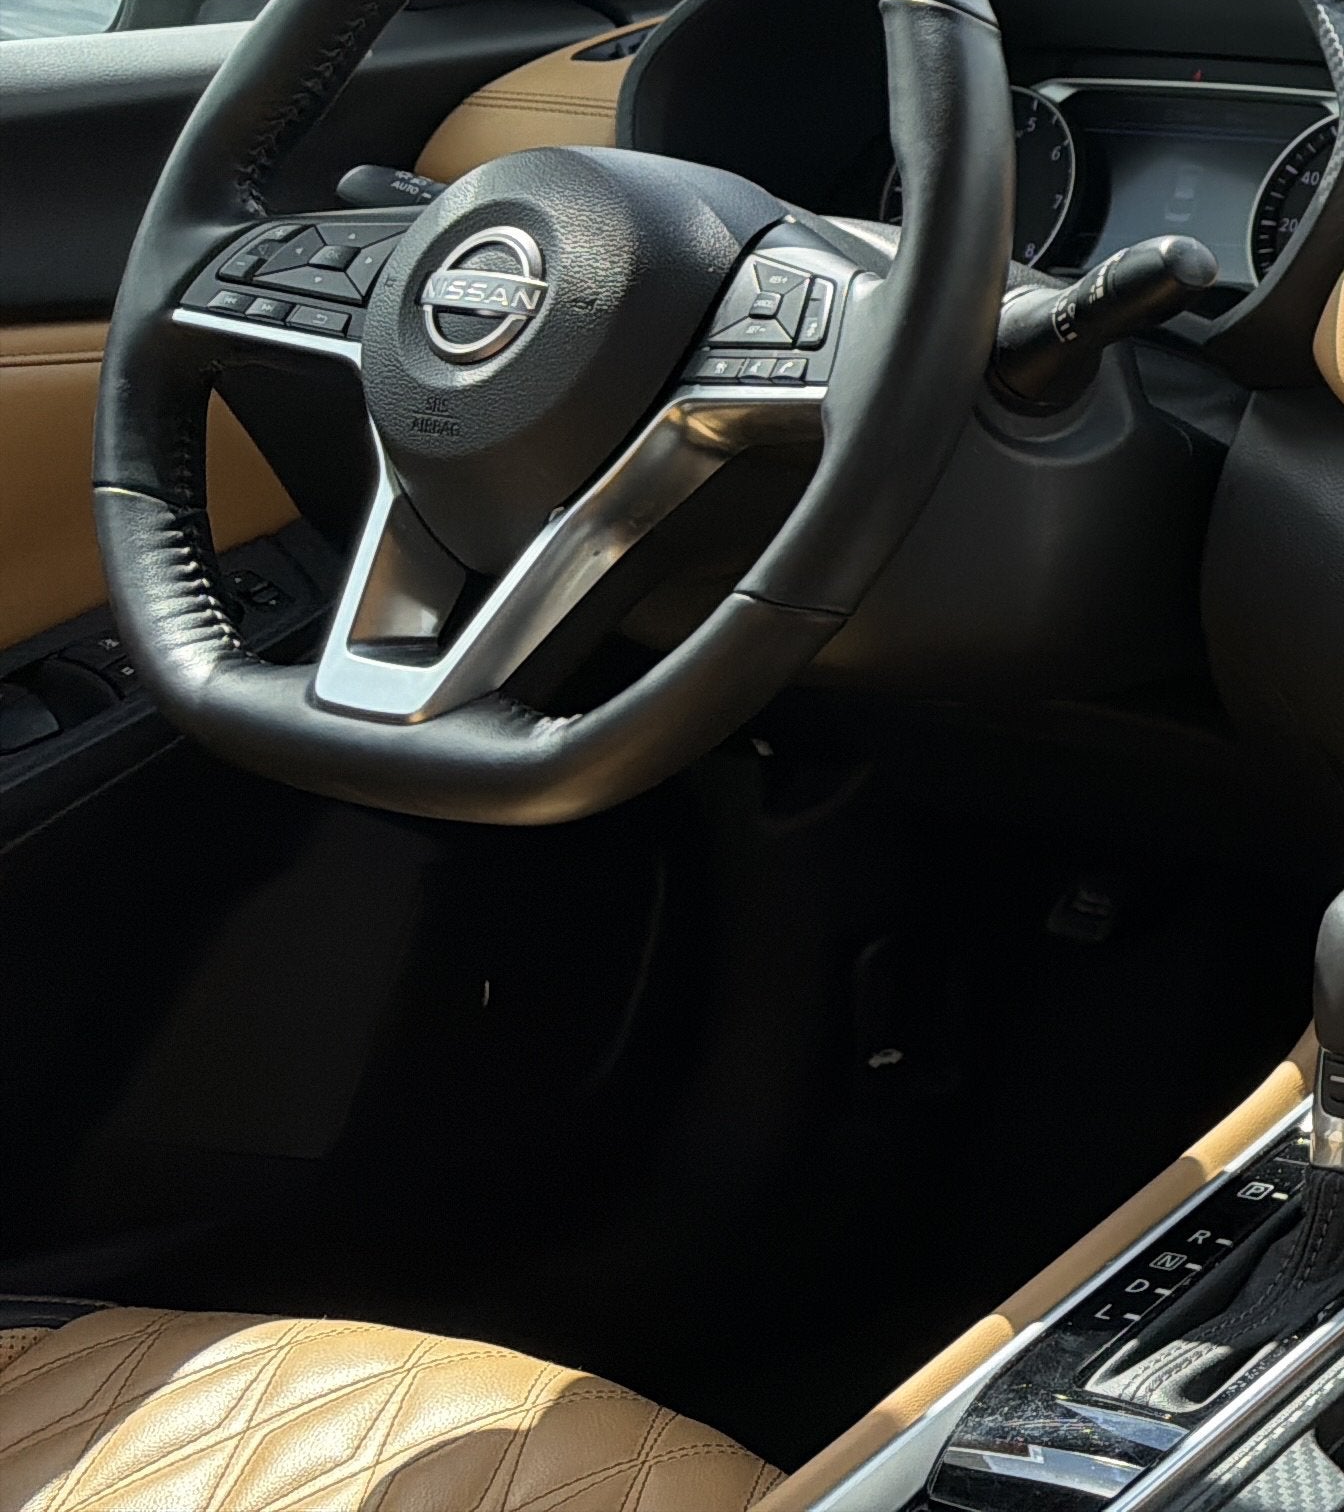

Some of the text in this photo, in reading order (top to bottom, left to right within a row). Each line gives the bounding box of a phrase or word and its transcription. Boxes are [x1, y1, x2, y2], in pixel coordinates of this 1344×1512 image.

[1027, 117, 1037, 134] 5
[1051, 145, 1061, 160] 6
[1301, 170, 1320, 187] 40
[1054, 194, 1063, 210] 7
[1279, 218, 1297, 233] 20
[1024, 243, 1035, 258] 8
[422, 278, 541, 310] NISSAN
[1245, 1185, 1264, 1196] P
[1187, 1230, 1211, 1244] R
[1157, 1254, 1178, 1268] N
[1125, 1279, 1149, 1292] D
[1095, 1304, 1112, 1320] L
